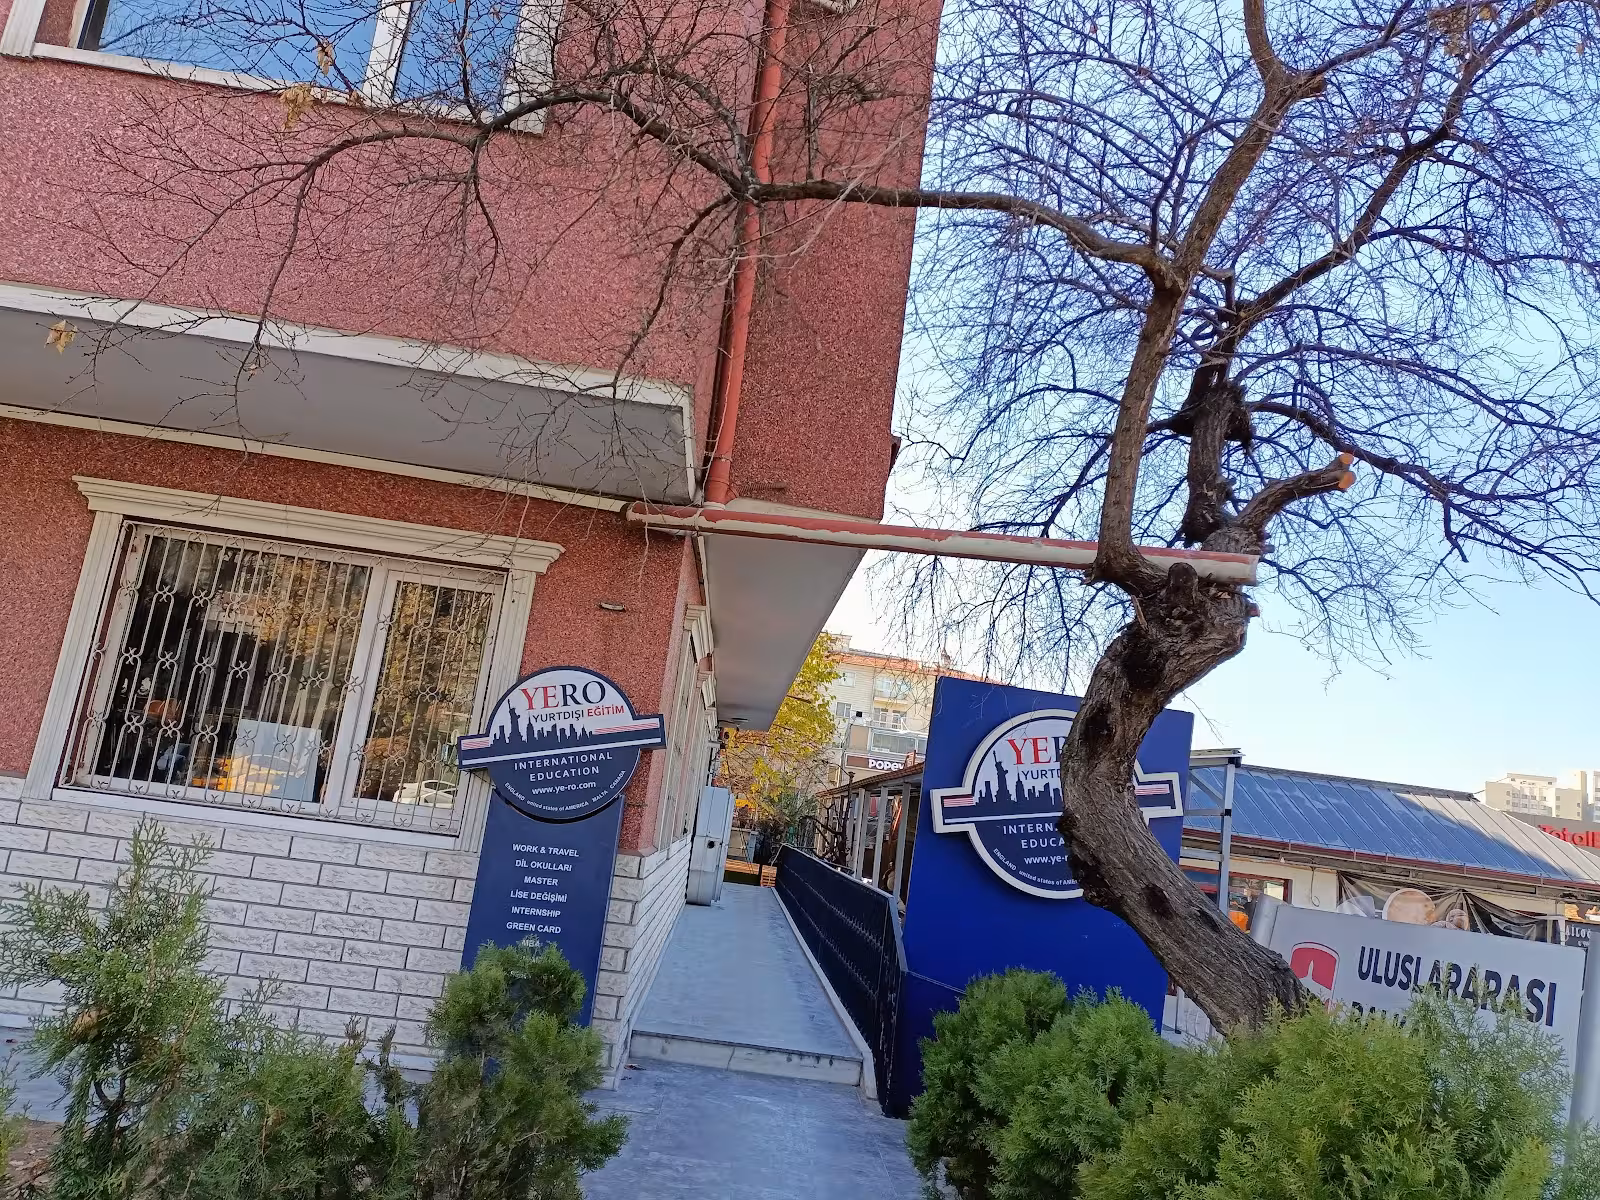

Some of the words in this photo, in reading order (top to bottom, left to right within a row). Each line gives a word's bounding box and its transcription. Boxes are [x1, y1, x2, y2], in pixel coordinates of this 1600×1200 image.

[519, 681, 606, 710] YERO
[533, 709, 584, 723] YURTDIŞI
[587, 704, 625, 717] EĞİTİM
[514, 751, 613, 771] INTERNATIONAL
[529, 766, 600, 782] EDUCATION
[504, 782, 526, 801] ENGLAND
[526, 799, 543, 809] united
[542, 804, 558, 812] states
[564, 801, 589, 812] AMERICA
[591, 790, 609, 802] MALTA
[609, 769, 626, 789] CANADA
[531, 781, 597, 795] www.ye-ro.com
[512, 843, 539, 853] WORK
[540, 846, 546, 854] &
[548, 846, 580, 857] TRAVEL
[1021, 837, 1065, 849] EDUCA
[515, 858, 529, 868] DİL
[530, 861, 573, 872] OKULLARI
[993, 847, 1017, 871] ENGLAND
[1018, 870, 1037, 881] united
[1037, 877, 1055, 886] states
[1024, 854, 1068, 865] www.ye-r
[523, 875, 559, 887] MASTER
[510, 889, 529, 899] LİSE
[530, 891, 568, 904] DEĞİŞİMİ
[511, 906, 561, 918] INTERNSHIP
[506, 921, 536, 932] GREEN
[537, 924, 562, 934] CARD
[1357, 945, 1557, 1027] ULUSLARARASI
